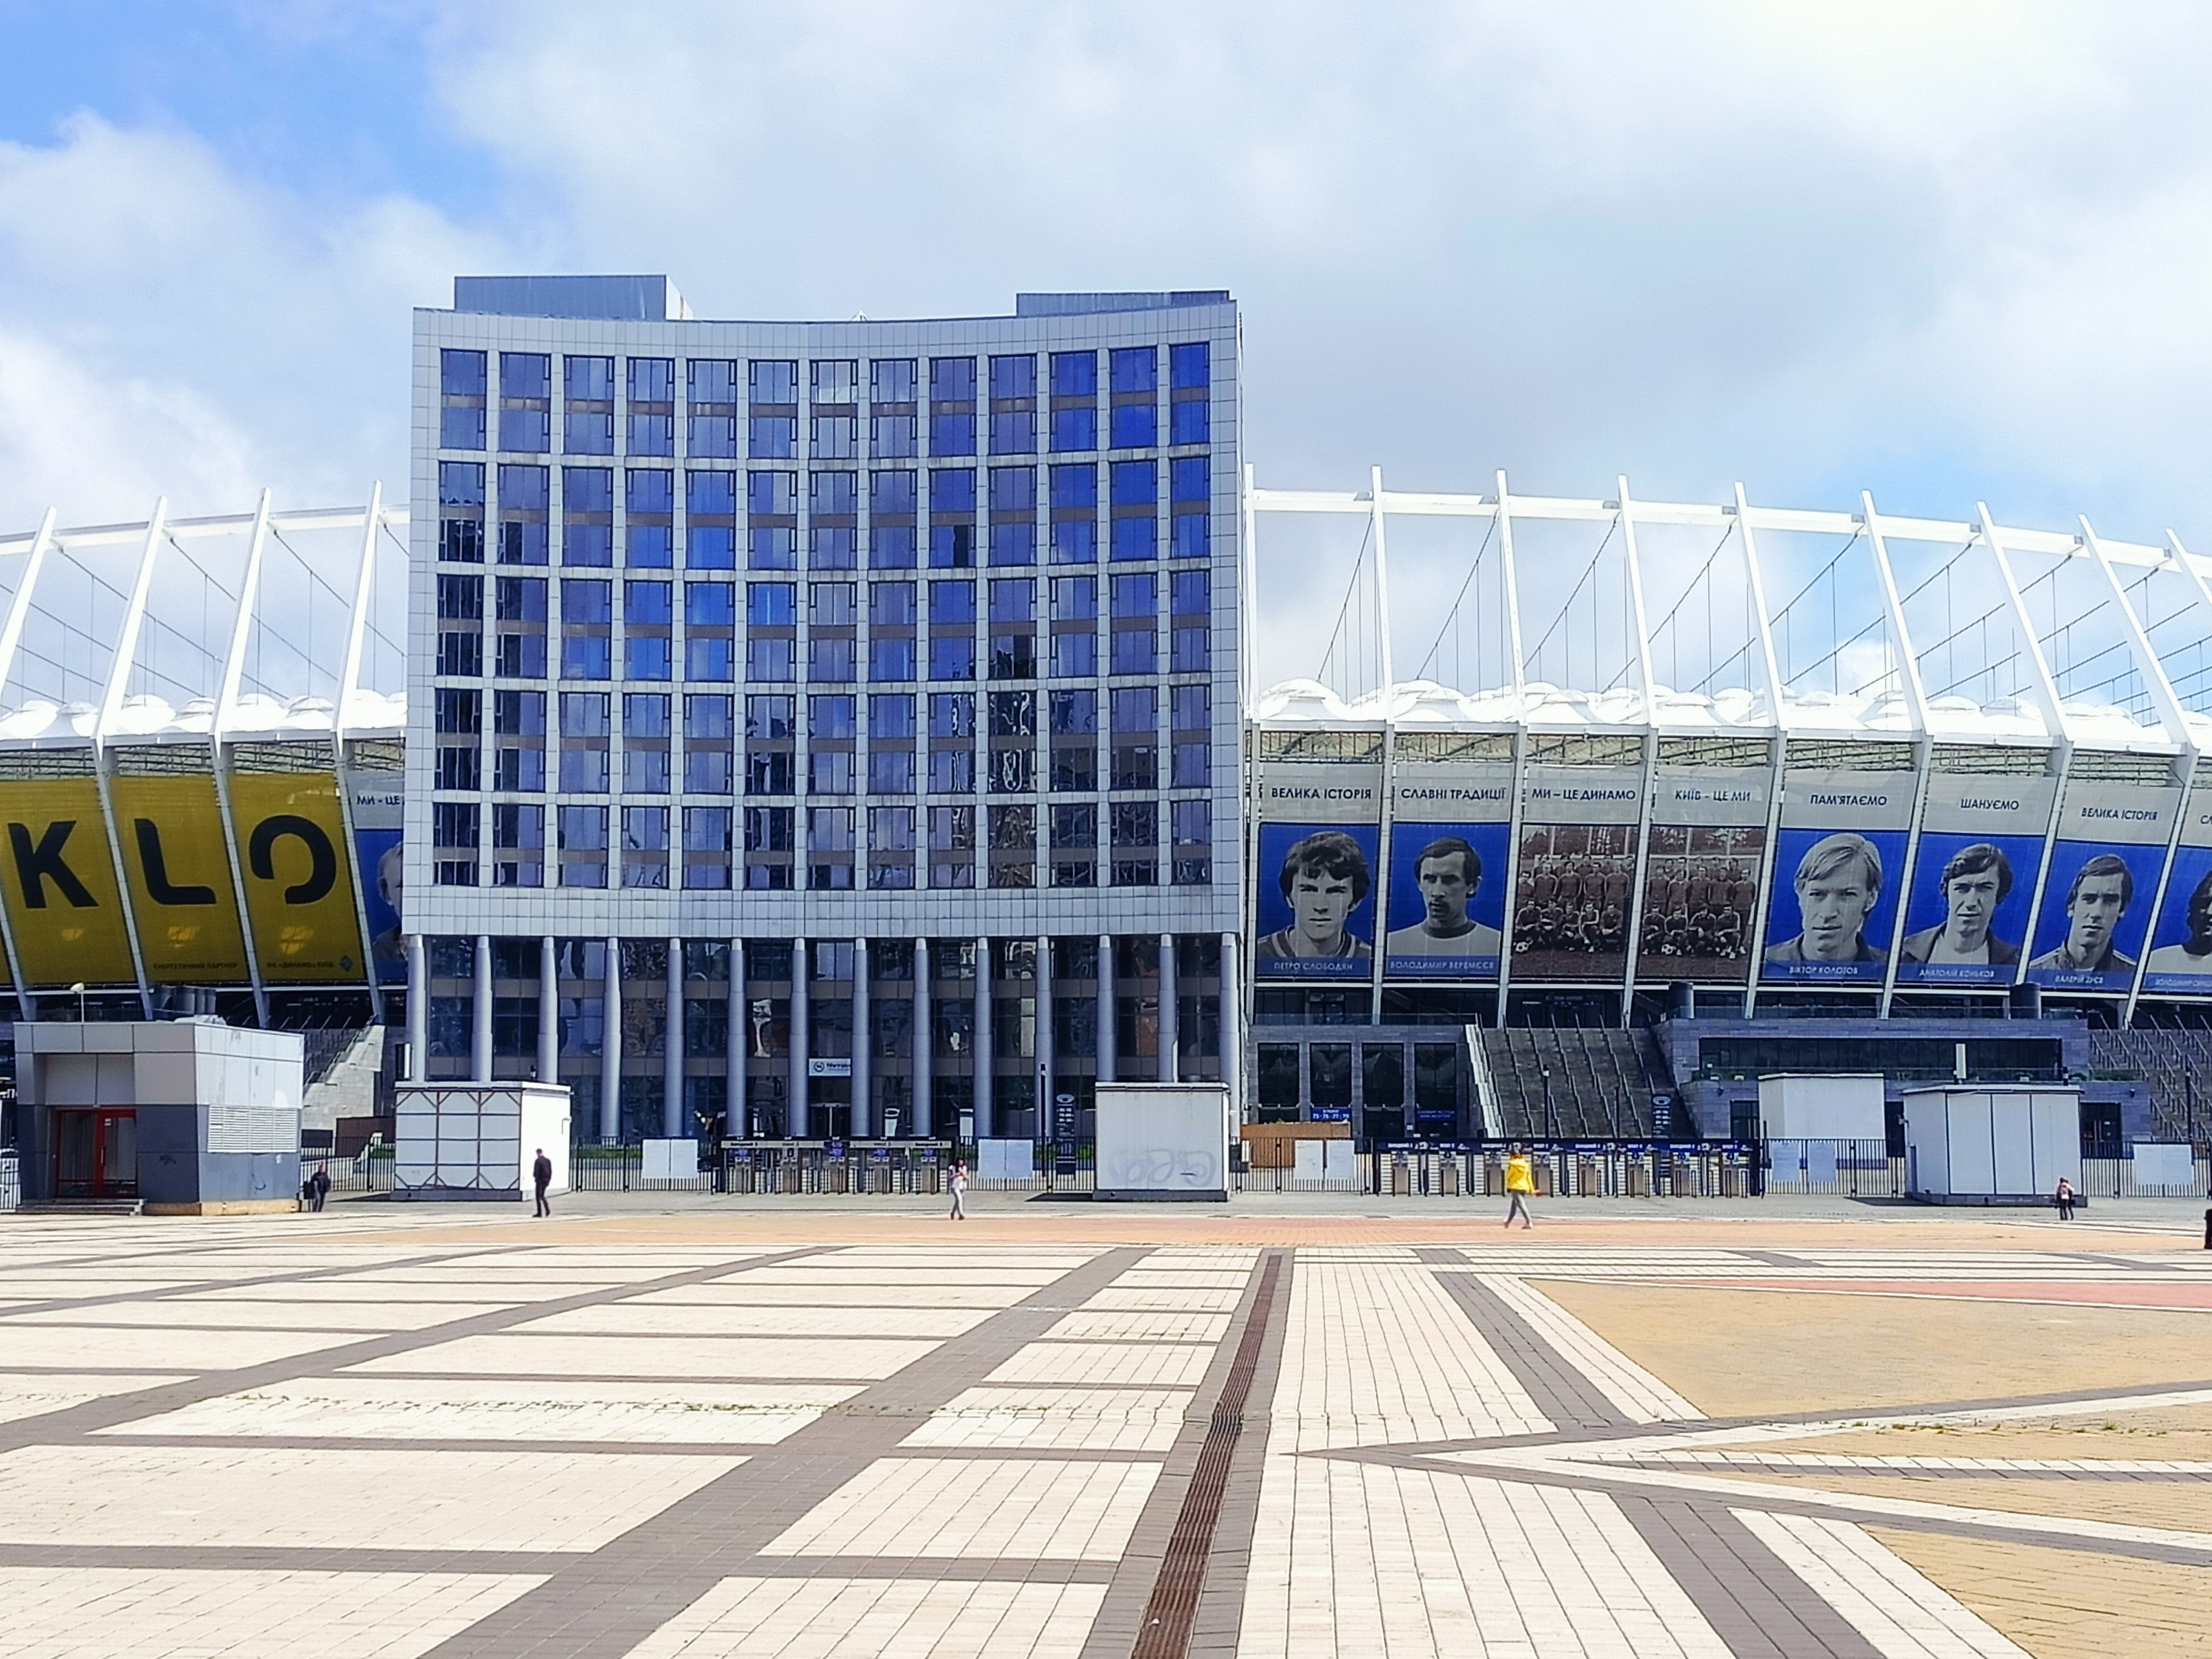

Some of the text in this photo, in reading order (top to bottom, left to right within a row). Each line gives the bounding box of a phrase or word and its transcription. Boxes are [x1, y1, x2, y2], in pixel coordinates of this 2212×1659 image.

[1271, 787, 1371, 800] ВЕЛИКА ІСТОРІЯ
[1401, 787, 1506, 801] СЛАВНІ ТРАДИЦІЇ
[1531, 788, 1551, 799] МИ
[1563, 789, 1579, 801] ЦЕ
[1579, 789, 1636, 801] ДИНАМО
[1674, 787, 1702, 801] КИЇВ
[1713, 790, 1729, 802] ЦЕ
[1730, 791, 1751, 802] МИ
[1810, 794, 1887, 806] ПАМ'ЯТАЄМО
[357, 795, 375, 805] МИ
[385, 795, 401, 806] ЦЕ
[1960, 798, 2019, 810] ШАНУЄМО
[2081, 807, 2158, 821] ВЕЛИКА ІСТОРІЯ
